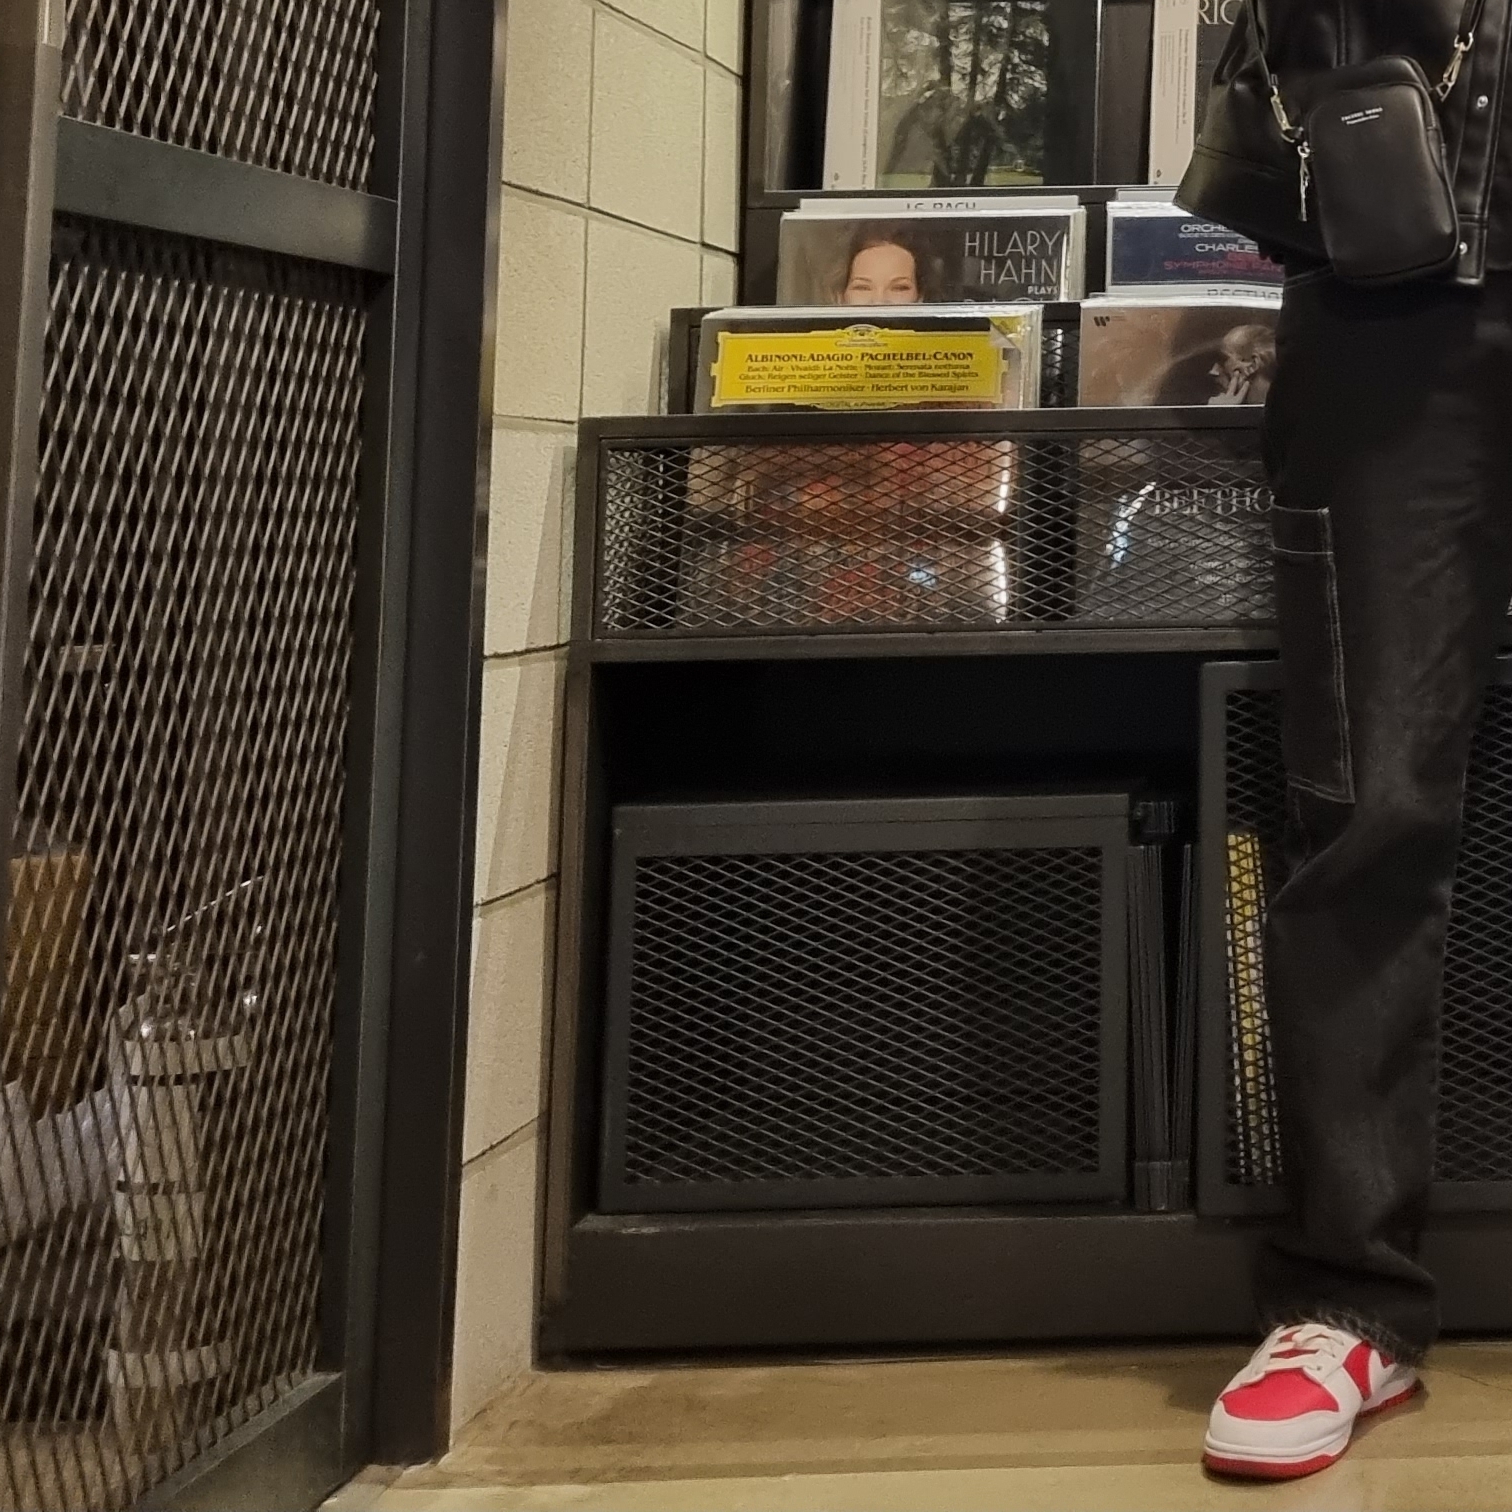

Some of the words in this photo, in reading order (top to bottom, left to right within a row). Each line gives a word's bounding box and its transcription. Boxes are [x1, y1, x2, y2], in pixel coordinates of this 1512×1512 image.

[964, 230, 1062, 257] HILARY
[1195, 243, 1260, 254] CHARLE
[980, 258, 1058, 285] HAHN
[1028, 285, 1059, 295] PLAYS
[745, 353, 806, 363] ALBINONI:
[807, 352, 853, 362] ADAGIO
[860, 351, 931, 361] PACHELBEL:
[932, 351, 974, 361] CANON
[745, 384, 787, 394] Berliner
[787, 383, 866, 393] Philharmoniker
[871, 383, 909, 392] Herbert
[910, 384, 929, 392] von
[930, 383, 970, 393] Karajan
